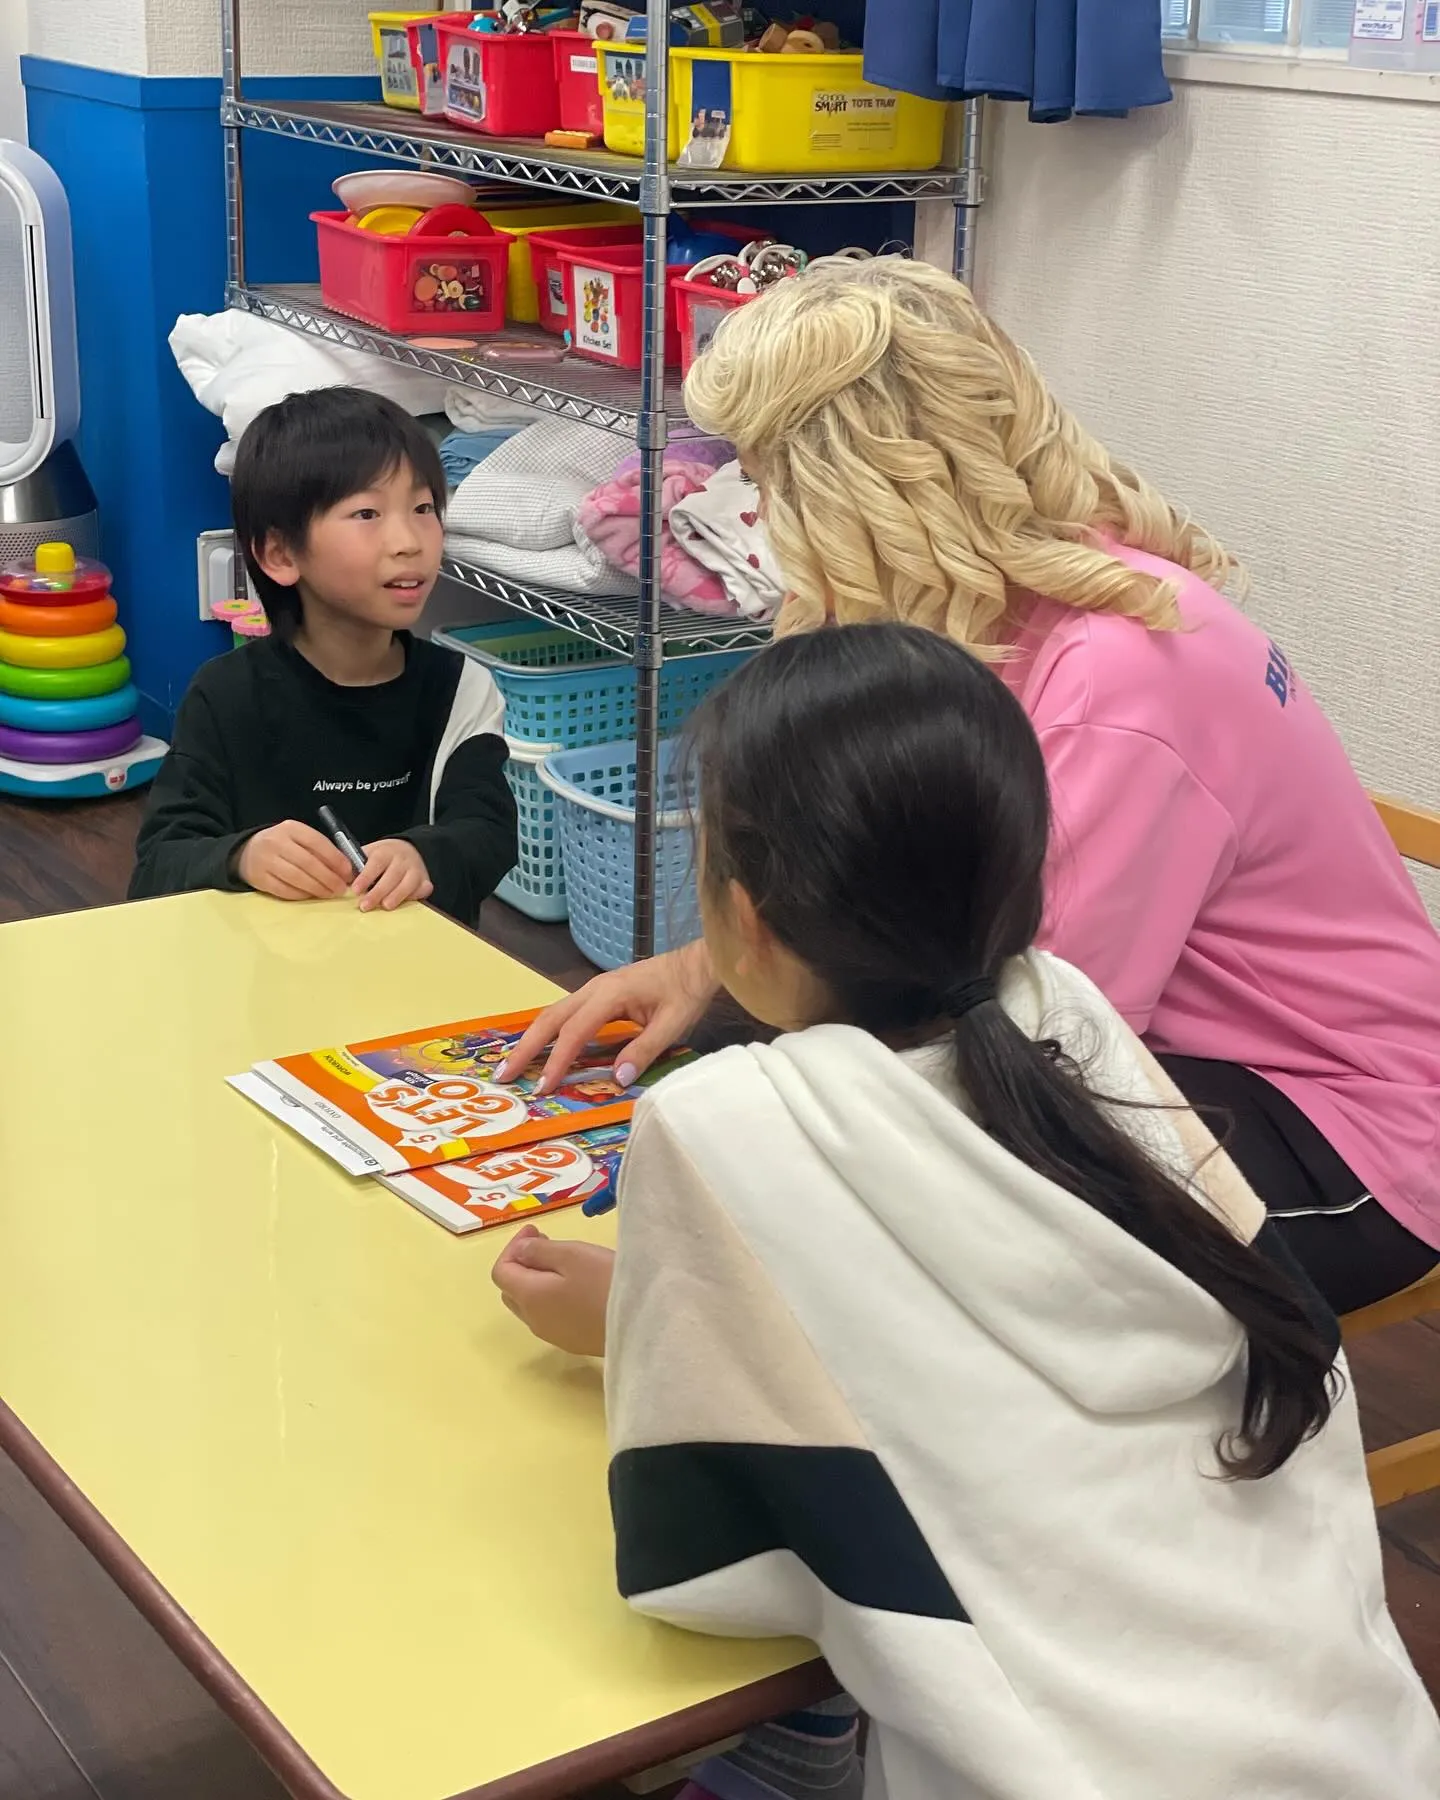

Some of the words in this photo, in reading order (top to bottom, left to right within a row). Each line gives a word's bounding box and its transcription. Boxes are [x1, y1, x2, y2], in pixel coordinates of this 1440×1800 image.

[815, 101, 848, 114] SMART
[852, 99, 873, 108] TOTE
[875, 99, 896, 108] TRAY
[312, 780, 354, 793] Always
[356, 780, 371, 791] be
[426, 1081, 515, 1115] GO
[368, 1086, 489, 1136] LET'S
[408, 1134, 437, 1144] 5
[477, 1192, 506, 1202] 5
